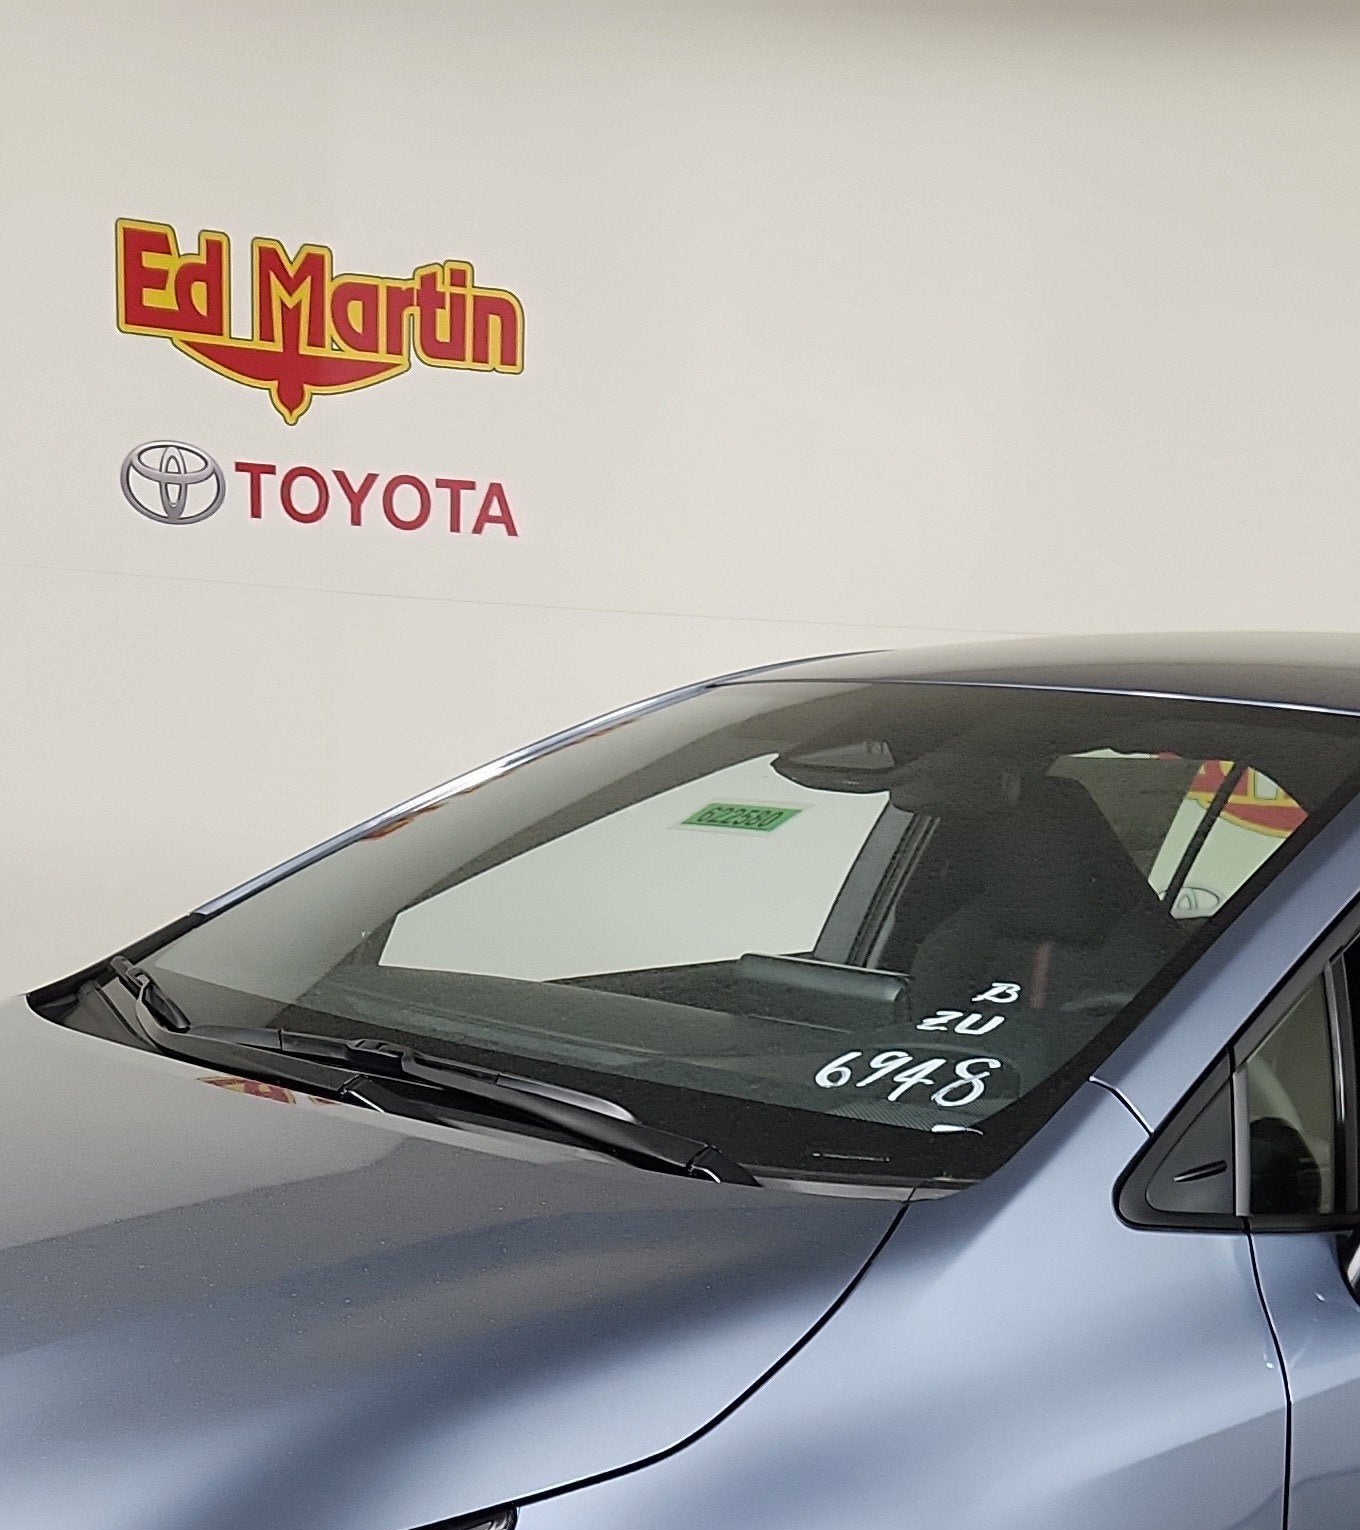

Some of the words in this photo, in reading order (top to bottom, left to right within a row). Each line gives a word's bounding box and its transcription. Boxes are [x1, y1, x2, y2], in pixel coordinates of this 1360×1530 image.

[116, 218, 230, 342] Ed
[252, 237, 524, 374] Martin
[234, 461, 519, 537] TOYOTA
[815, 1051, 1002, 1107] 6948
